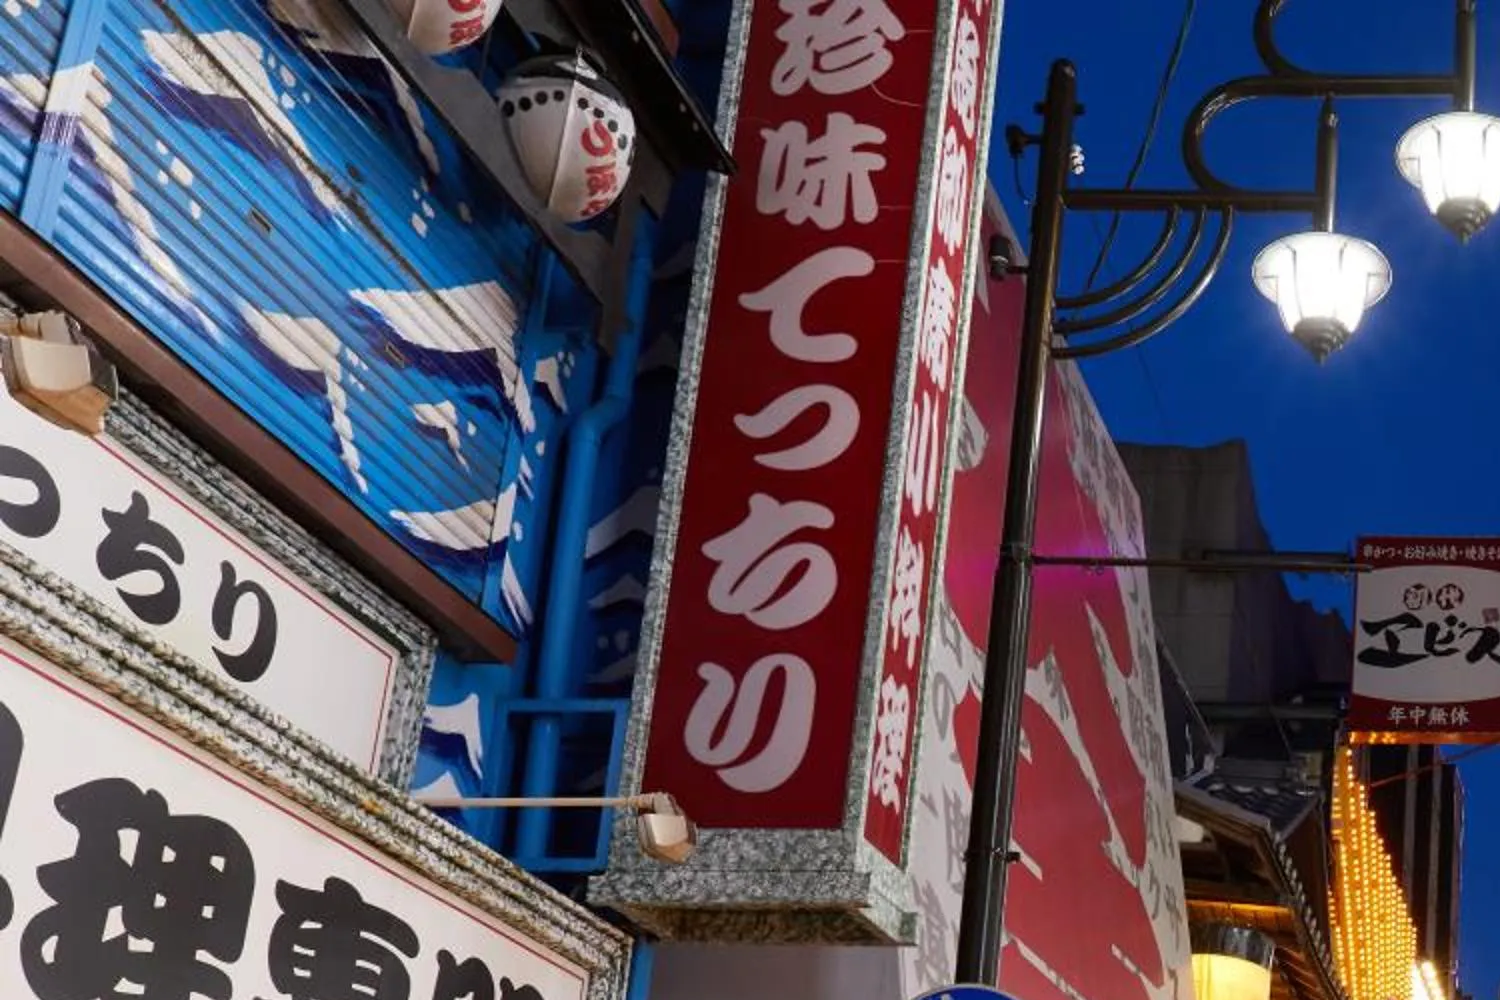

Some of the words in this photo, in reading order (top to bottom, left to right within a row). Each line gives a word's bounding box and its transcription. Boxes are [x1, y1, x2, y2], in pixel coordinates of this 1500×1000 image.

[684, 0, 906, 794] 珍味てっちり
[1388, 706, 1470, 728] 年中無休
